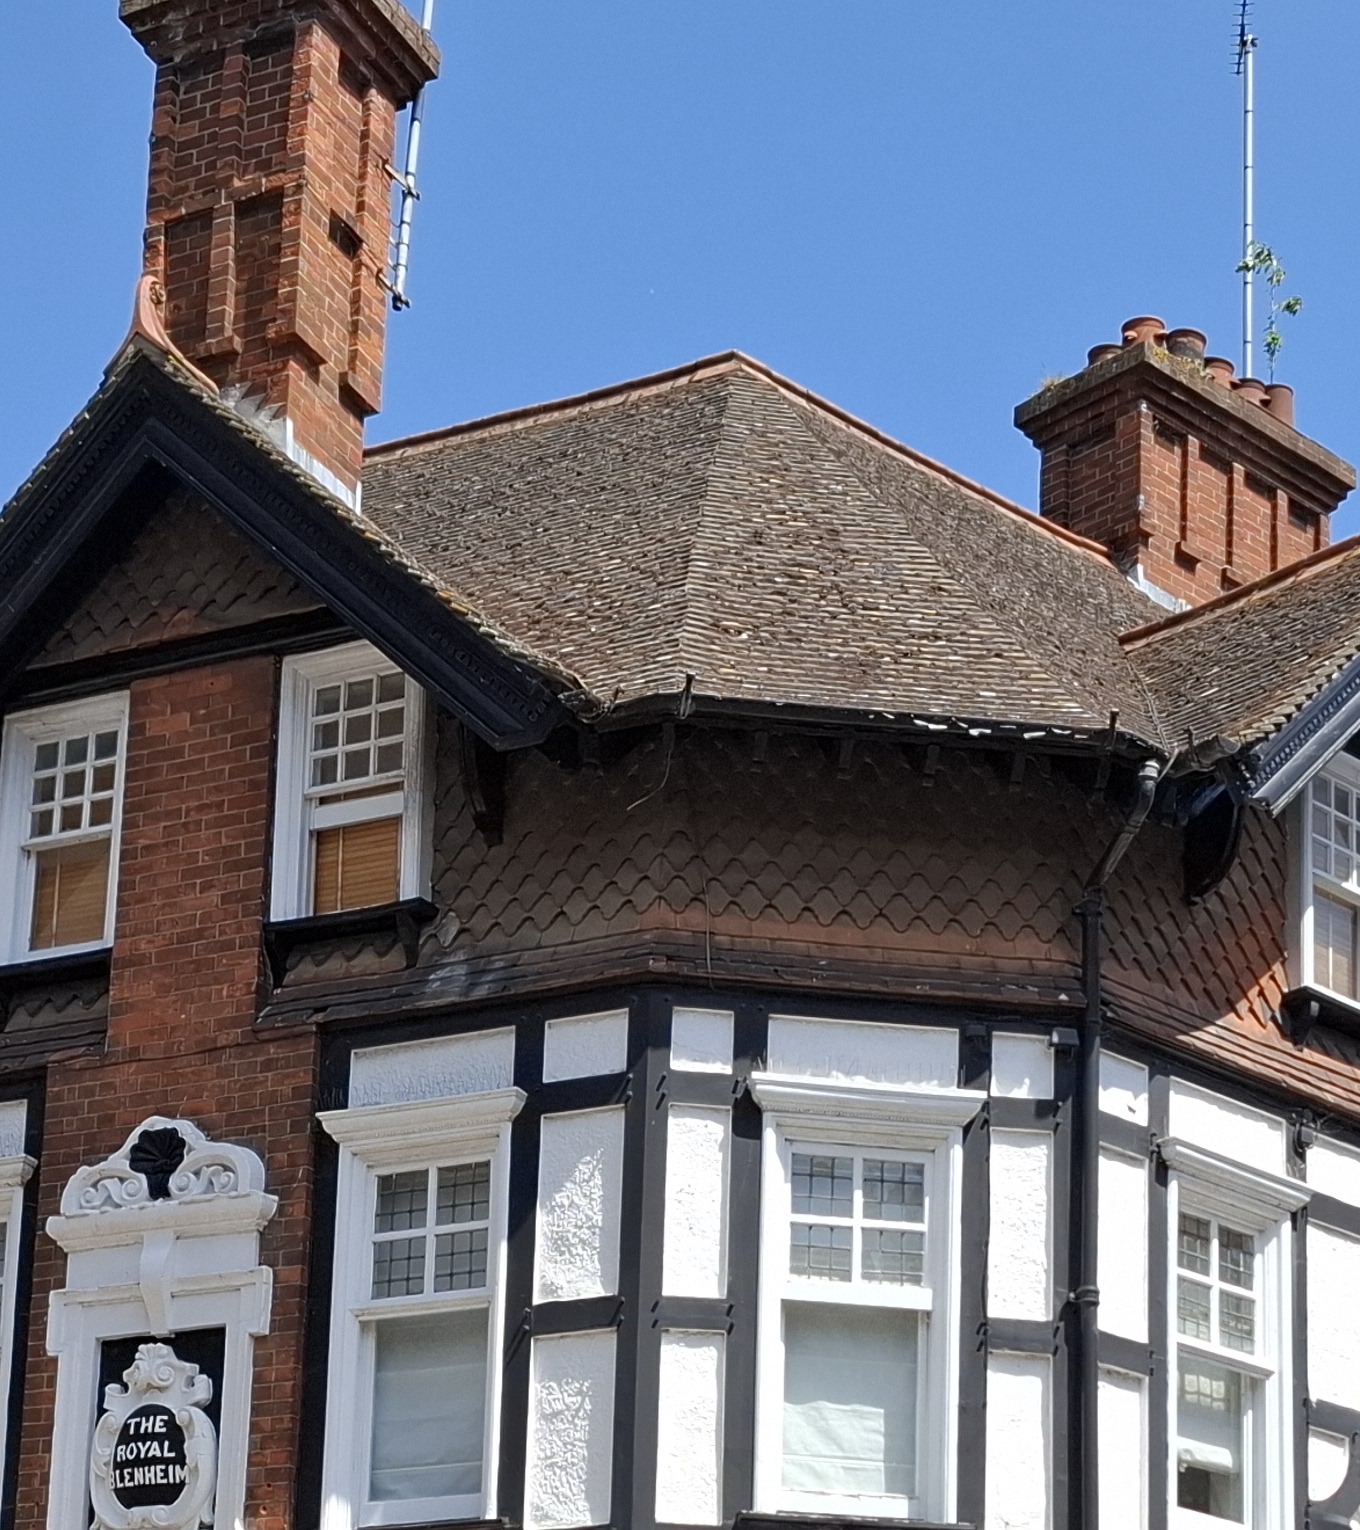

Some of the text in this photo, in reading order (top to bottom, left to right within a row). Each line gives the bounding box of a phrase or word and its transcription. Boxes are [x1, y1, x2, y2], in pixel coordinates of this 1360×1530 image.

[127, 1415, 169, 1435] THE
[116, 1441, 176, 1462] ROYAL
[109, 1464, 190, 1490] BLENHEIM
